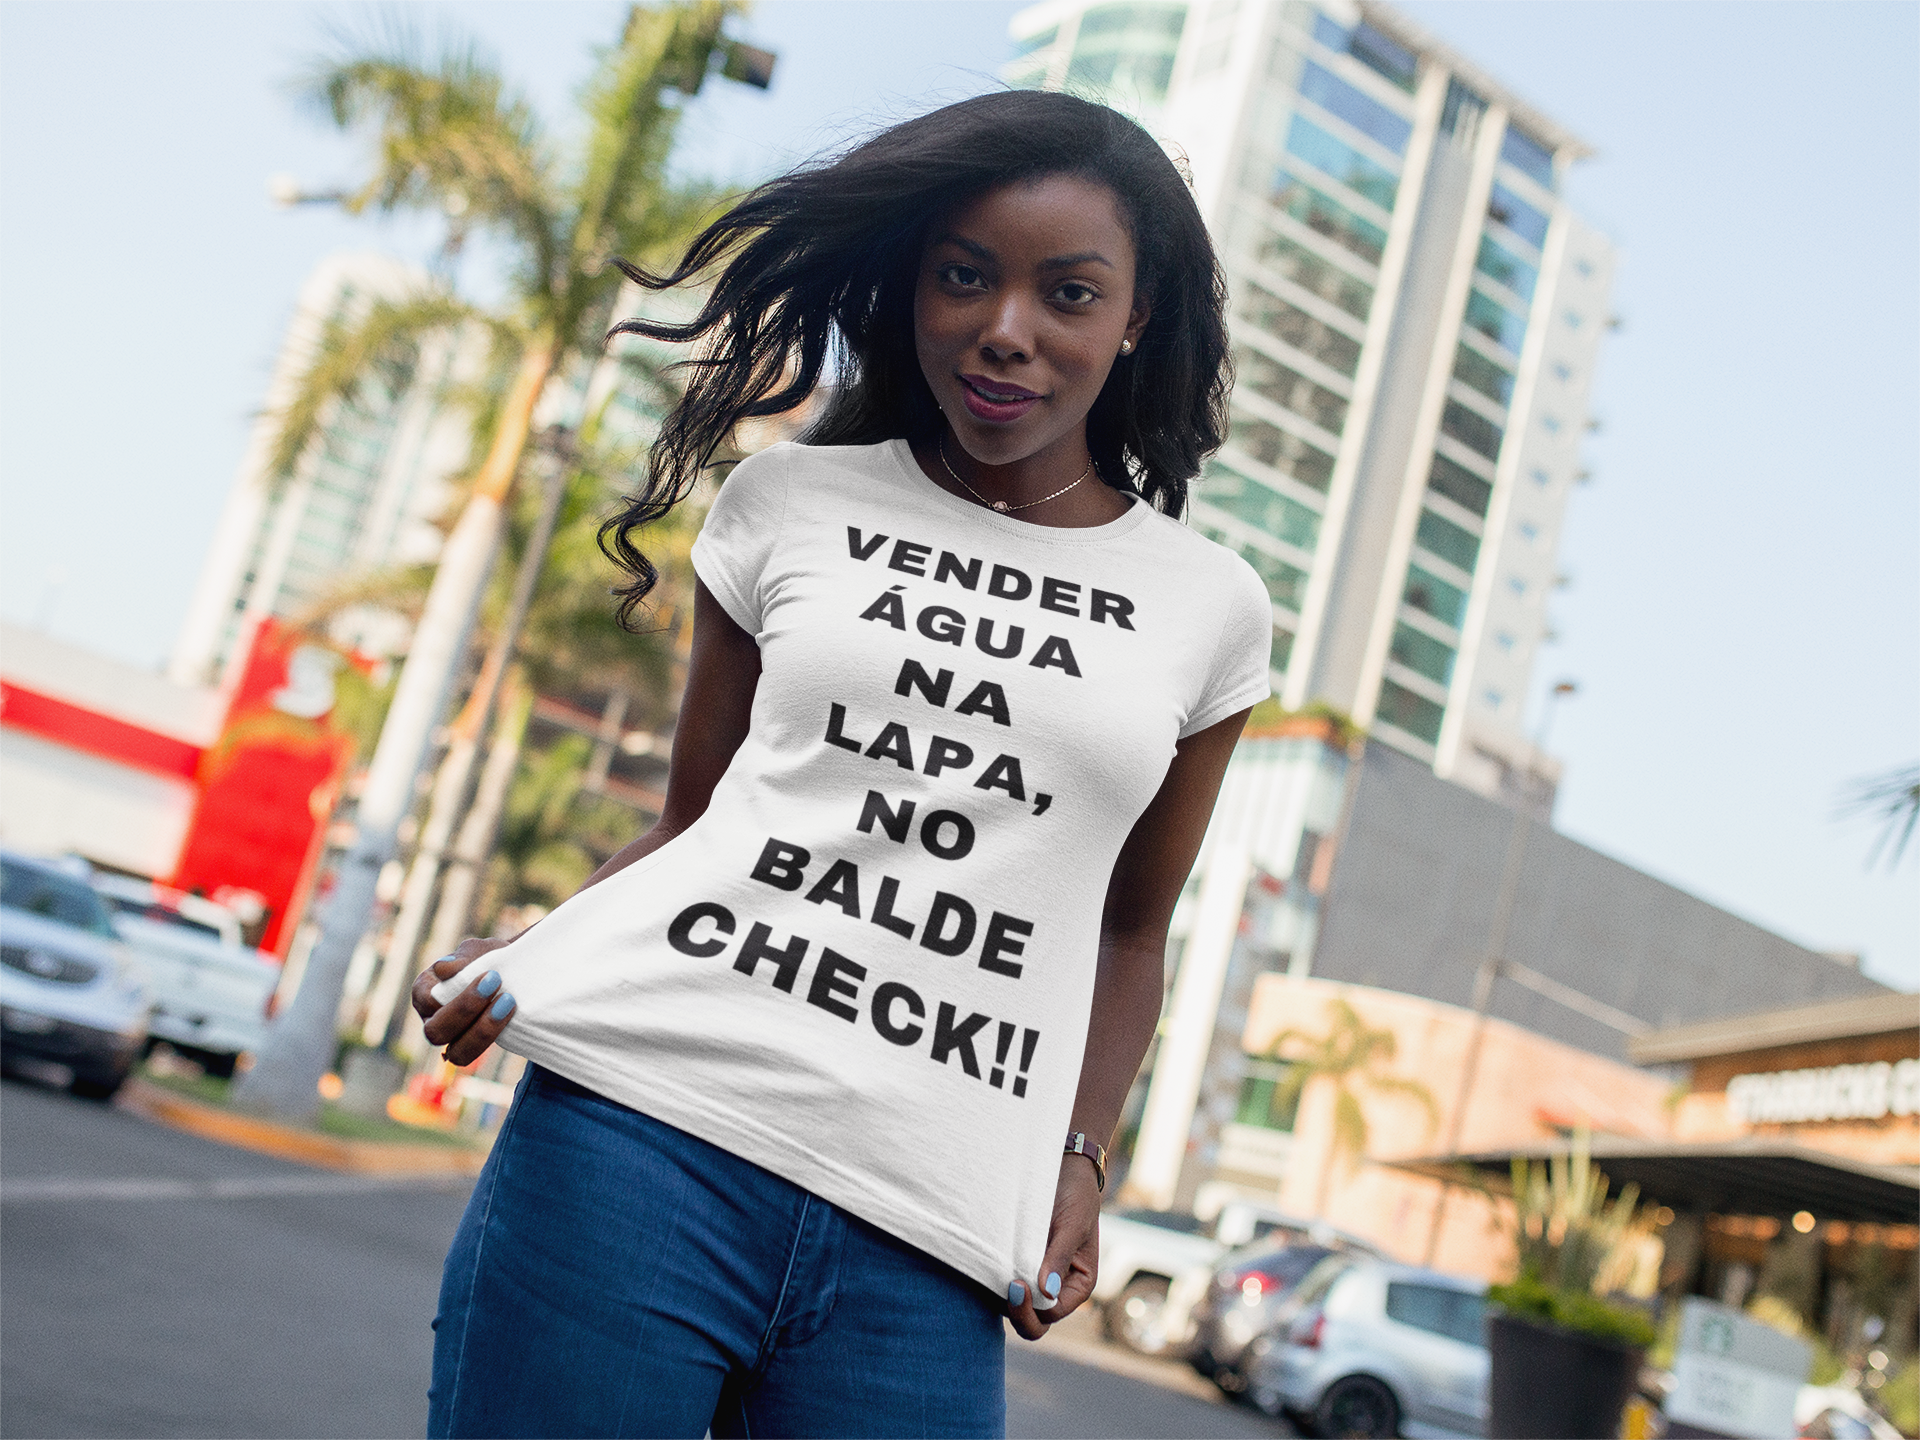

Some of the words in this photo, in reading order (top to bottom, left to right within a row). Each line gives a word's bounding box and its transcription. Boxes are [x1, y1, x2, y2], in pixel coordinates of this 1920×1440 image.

[848, 526, 1136, 632] VENDER
[860, 586, 1082, 678] ÁGUA
[895, 658, 1011, 727] NA
[825, 702, 1053, 816] LAPA,
[856, 790, 976, 861] NO
[750, 838, 1034, 980] BALDE
[667, 902, 1040, 1099] CHECK!!
